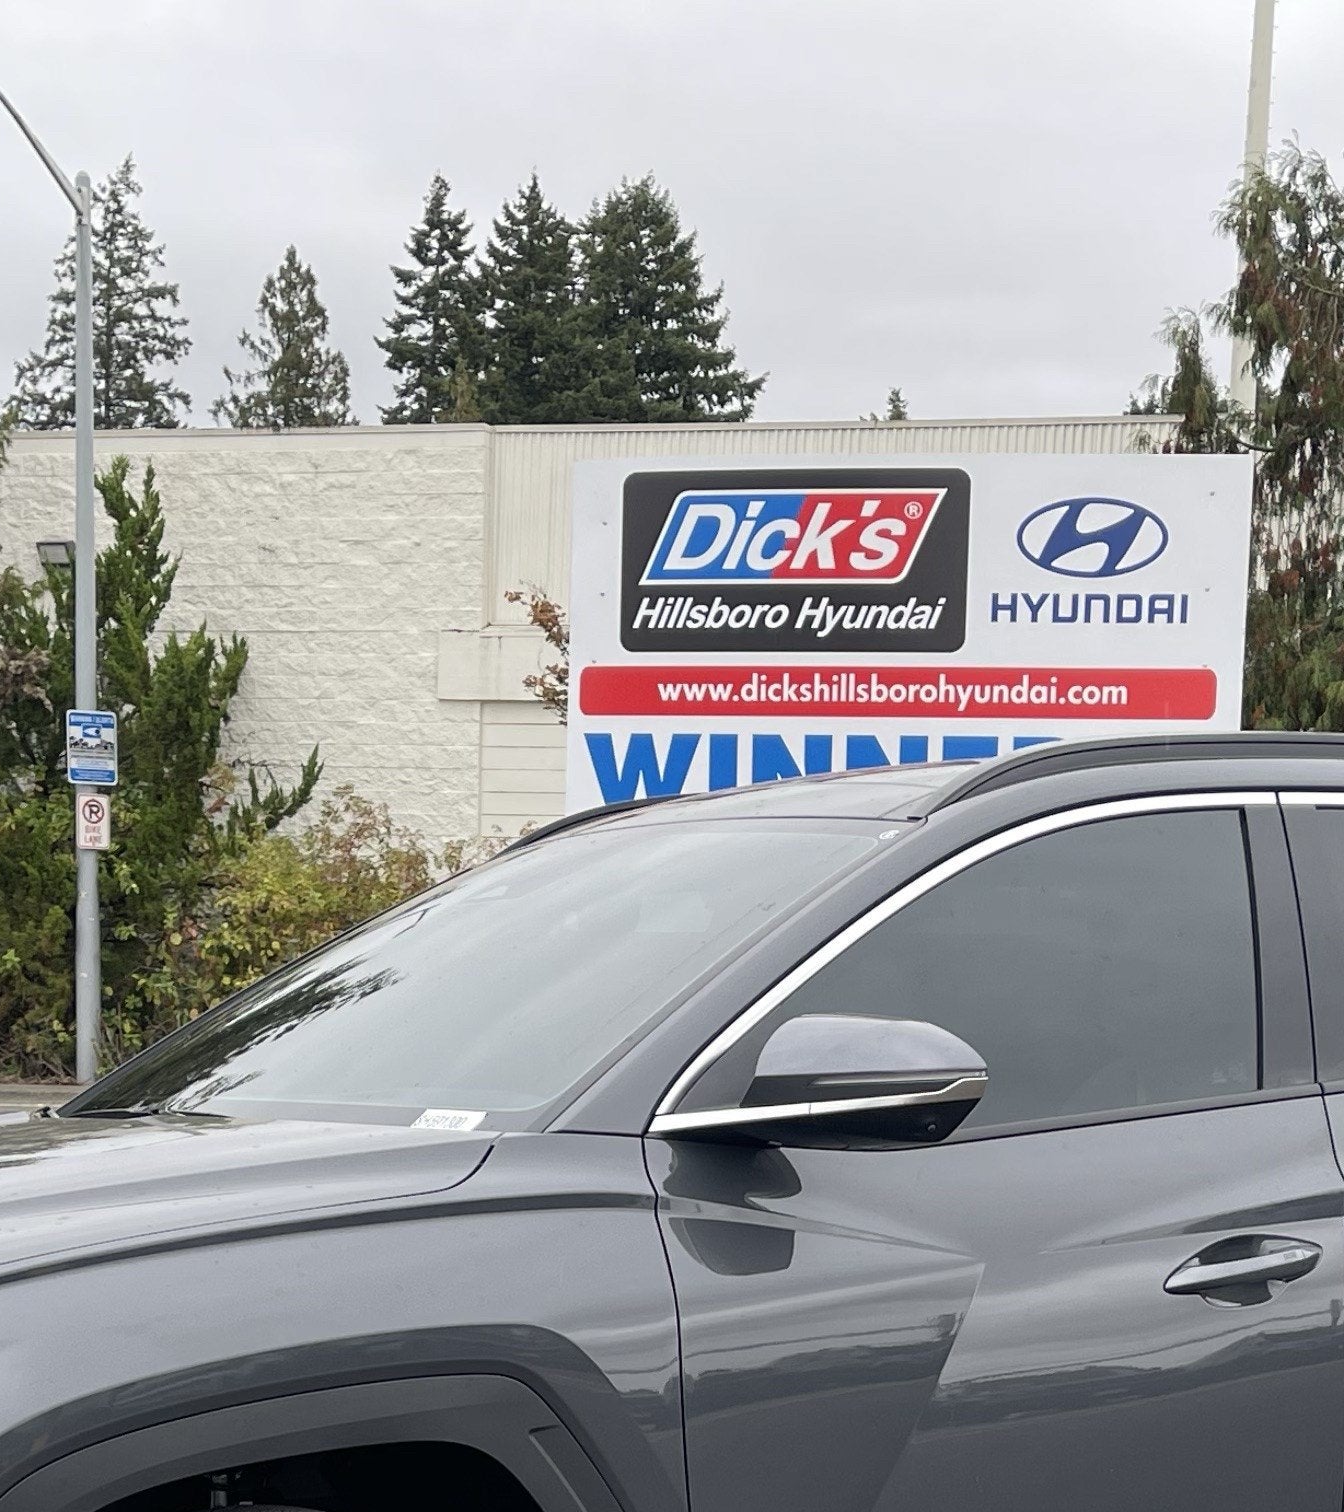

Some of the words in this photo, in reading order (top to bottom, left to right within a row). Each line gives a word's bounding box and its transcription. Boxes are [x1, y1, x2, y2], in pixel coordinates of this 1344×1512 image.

[632, 596, 790, 630] Hillsboro
[794, 596, 947, 638] Hyundai
[989, 593, 1188, 624] HYUNDAI
[657, 672, 1128, 712] www.dickshillsborohyundai.com
